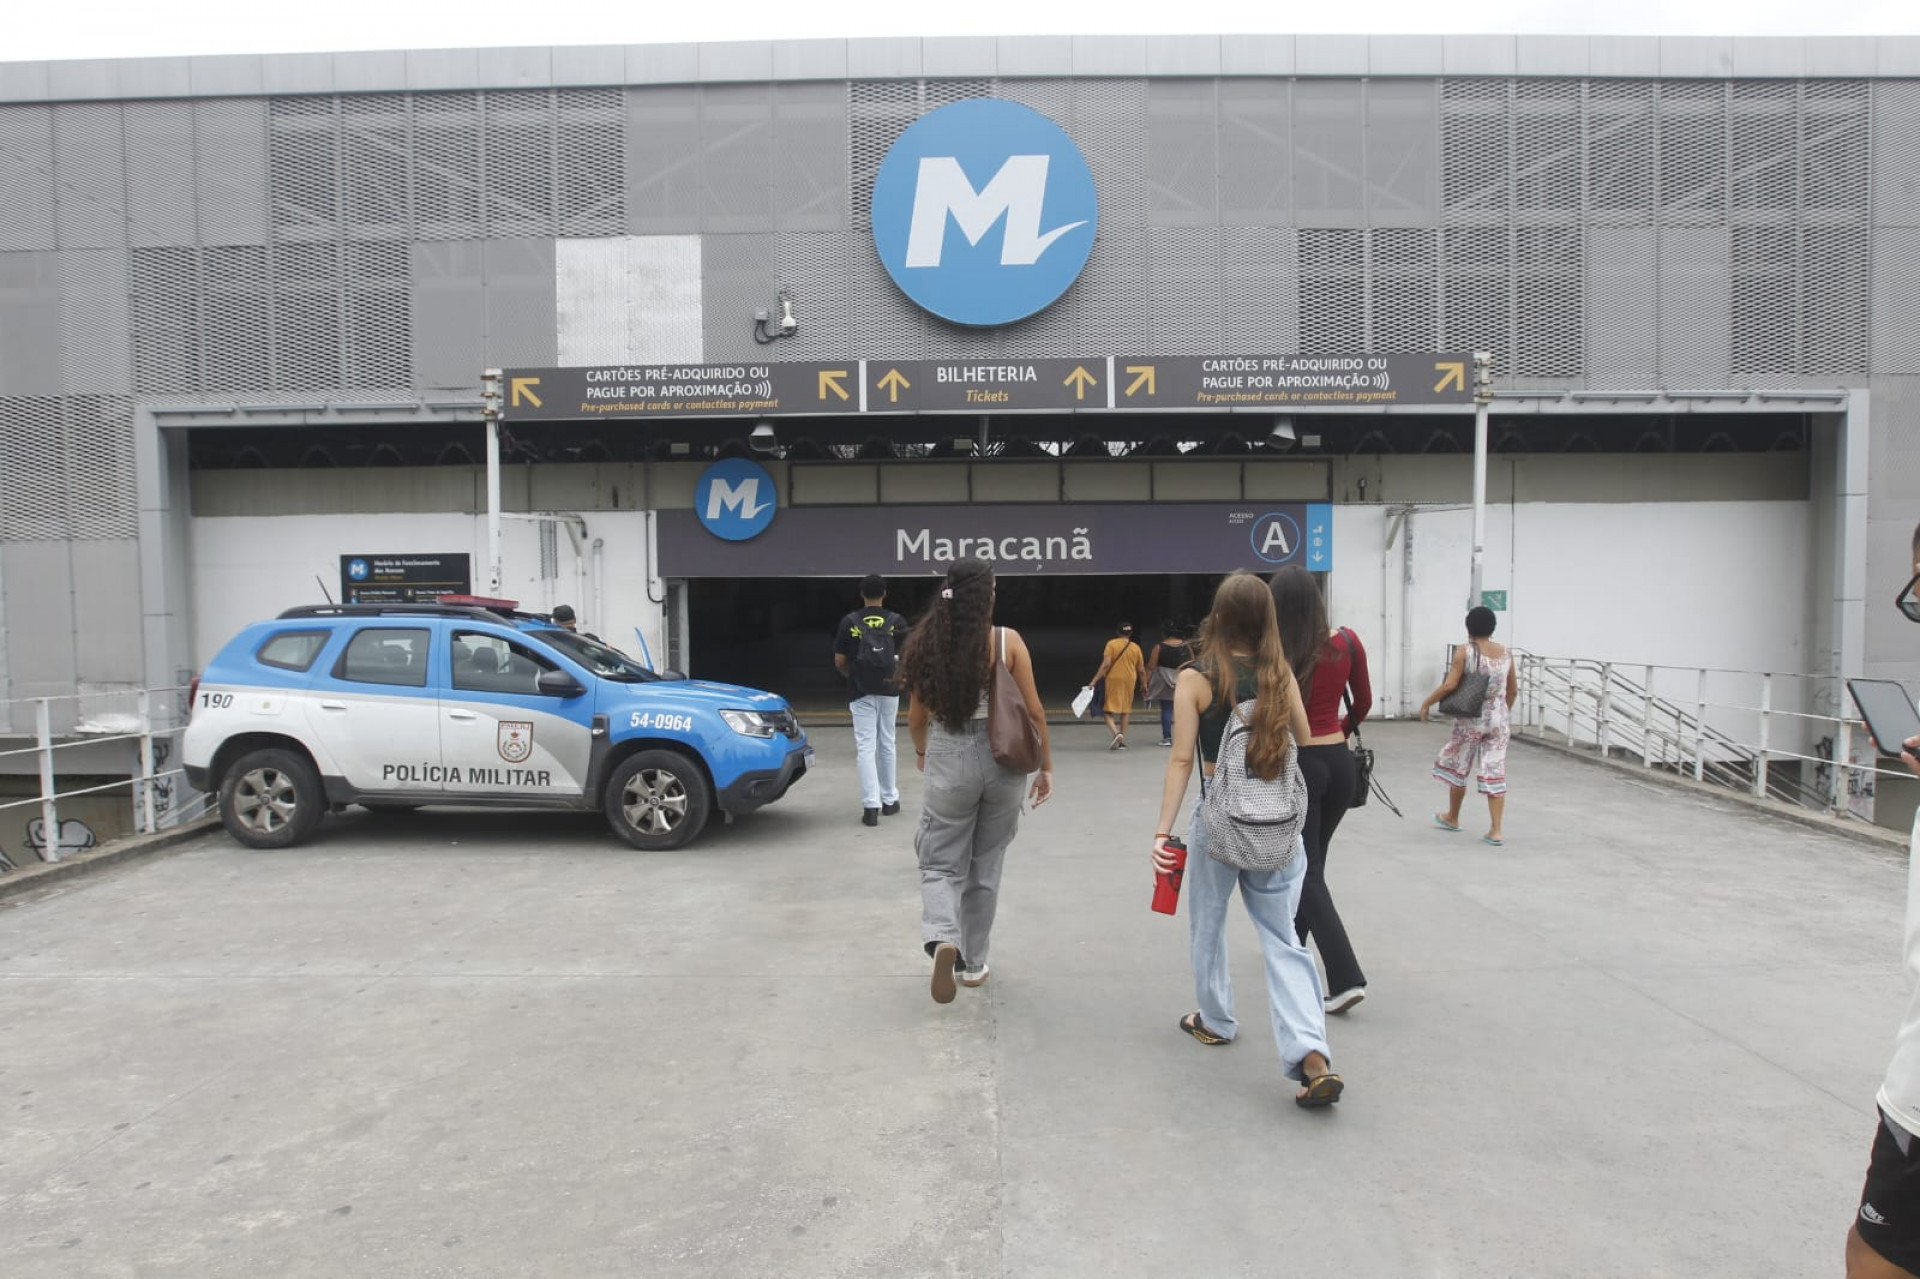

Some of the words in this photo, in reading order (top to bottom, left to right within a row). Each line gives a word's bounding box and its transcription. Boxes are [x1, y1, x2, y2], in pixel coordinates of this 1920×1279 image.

[1202, 357, 1259, 372] CARTÕES
[1262, 356, 1364, 372] PRÉ-ADQUIRIDO
[1367, 358, 1387, 370] OU
[586, 366, 642, 382] CARTÕES
[645, 365, 745, 381] PRÉ-ADQUIRIDO
[749, 366, 769, 379] OU
[936, 365, 1038, 383] BILHETERIA
[1203, 376, 1243, 389] PAGUE
[1247, 376, 1273, 388] POR
[1278, 372, 1370, 390] APROXIMAÇÃO
[586, 386, 627, 399] PAGUE
[629, 385, 656, 398] POR
[660, 381, 752, 399] APROXIMAÇÃO
[965, 389, 1009, 402] Tickets
[1196, 391, 1263, 403] Pre-purchased
[1264, 391, 1288, 401] cards
[1290, 393, 1301, 401] or
[1303, 391, 1355, 401] contactless
[1355, 390, 1397, 402] payment
[581, 401, 645, 413] Pre-purchased
[647, 400, 671, 410] cards
[673, 401, 684, 410] or
[685, 400, 737, 410] contactless
[738, 399, 779, 411] payment
[896, 527, 1093, 562] Maracanã
[1260, 521, 1290, 554] A
[201, 692, 234, 709] 190
[630, 711, 692, 733] 54-0964
[383, 762, 461, 783] POLÍCIA
[468, 767, 551, 787] MILITAR
